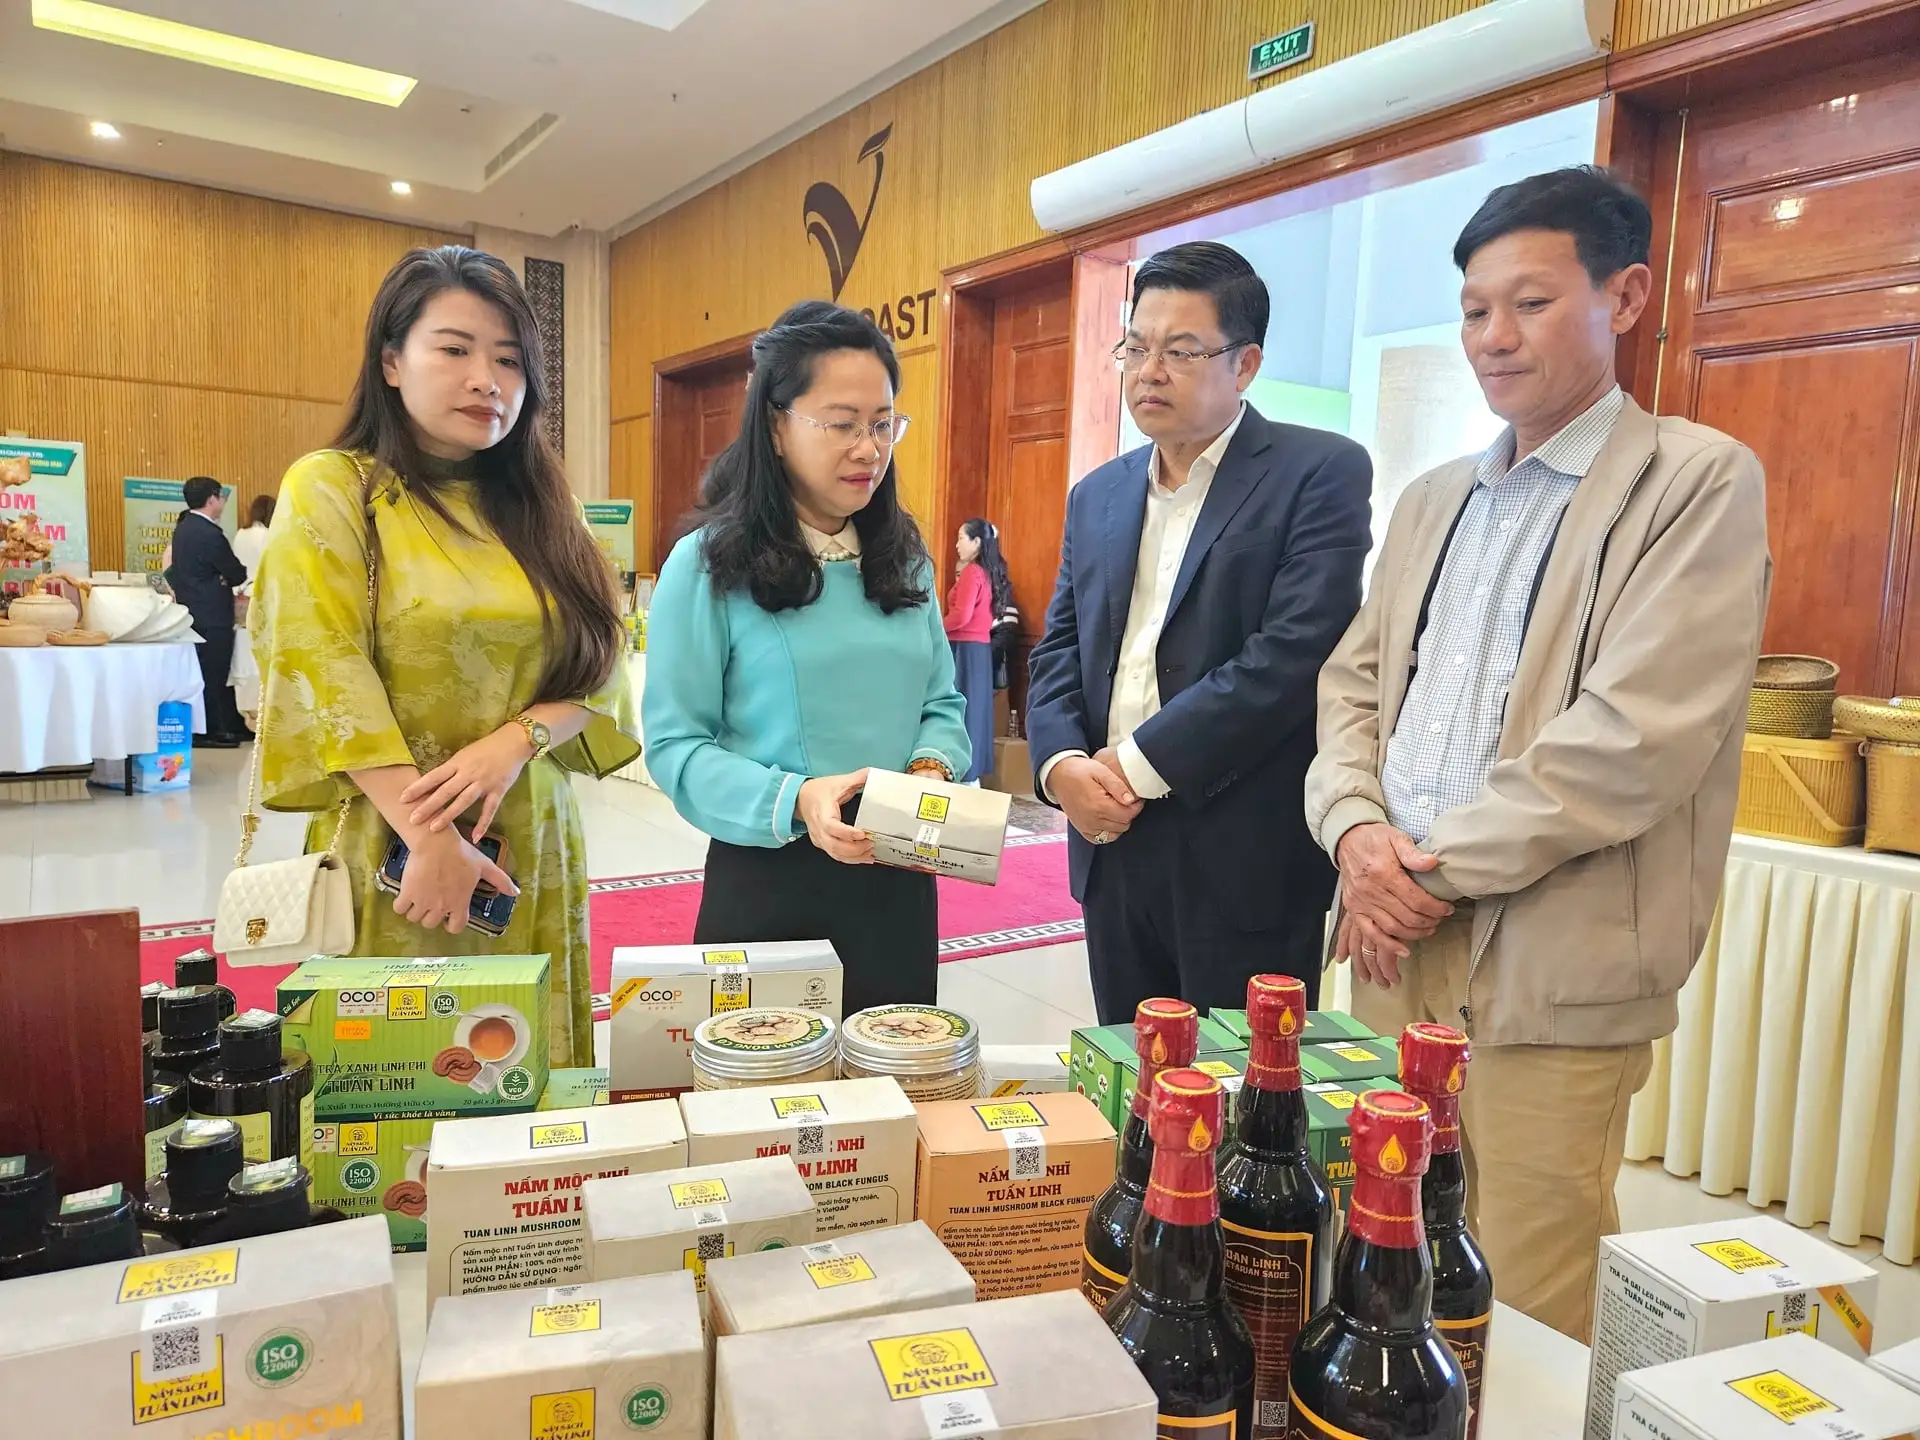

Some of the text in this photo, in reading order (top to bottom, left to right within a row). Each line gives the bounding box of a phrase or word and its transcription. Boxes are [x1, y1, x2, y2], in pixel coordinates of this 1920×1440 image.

[1260, 32, 1302, 61] EXIT
[860, 288, 937, 342] AST
[340, 991, 385, 1003] OCOP
[437, 998, 452, 1006] ISO
[640, 990, 683, 1002] OCOP
[347, 1063, 377, 1073] XANH
[381, 1062, 405, 1072] LINH
[409, 1061, 426, 1072] CHI
[328, 1076, 415, 1093] TUẤN LINH
[326, 1101, 347, 1110] Xuất
[351, 1101, 372, 1110] Theo
[384, 1109, 456, 1119] sức khỏe là vàng
[314, 1128, 335, 1139] OP
[837, 1136, 865, 1151] NHĨ
[349, 1168, 371, 1178] ISO
[816, 1158, 857, 1176] LINH
[978, 1161, 1070, 1183] NẤM NHĨ
[505, 1176, 549, 1195] NẤM
[826, 1179, 853, 1189] BLACK
[856, 1174, 889, 1185] FUNGUS
[987, 1184, 1062, 1201] TUẤN LINH
[331, 1196, 376, 1207] LINH CHI
[512, 1194, 568, 1218] TUẤN
[823, 1204, 849, 1213] VietGAP
[992, 1202, 1038, 1212] MUSHROOM
[1040, 1199, 1065, 1207] BLACK
[1066, 1195, 1096, 1205] FUNGUS
[463, 1218, 581, 1238] TUAN LINH MUSHROOM
[463, 1238, 573, 1256] Nấm mộc nhĩ Tuấn Linh được
[479, 1255, 497, 1263] xuất
[499, 1253, 517, 1262] khép
[533, 1249, 545, 1257] với
[546, 1248, 560, 1257] quy
[463, 1265, 493, 1274] THÀNH
[495, 1261, 523, 1271] PHẦN:
[547, 1255, 564, 1264] nấm
[565, 1253, 582, 1261] mộc
[1226, 1249, 1281, 1270] UAN LINH
[463, 1268, 531, 1285] HƯỚNG DẪN SỬ
[1226, 1260, 1290, 1279] ETARIAN SAUCE
[125, 1273, 231, 1298] TUẤN LINH
[462, 1276, 556, 1295] phẩm trước lúc chế biến
[1630, 1280, 1686, 1321] GAI LEO LINH CHI
[1644, 1301, 1664, 1319] LINH
[262, 1343, 298, 1364] ISO
[262, 1358, 298, 1374] 22000
[903, 1362, 969, 1378] NẤM SẠCH
[150, 1381, 208, 1400] NẤM SẠCH
[893, 1370, 987, 1394] TUẤN LINH
[139, 1390, 219, 1418] TUẤN LINH
[632, 1397, 660, 1411] ISO
[1806, 1401, 1828, 1413] LINH
[632, 1407, 660, 1420] 22000
[566, 1429, 591, 1439] LINH
